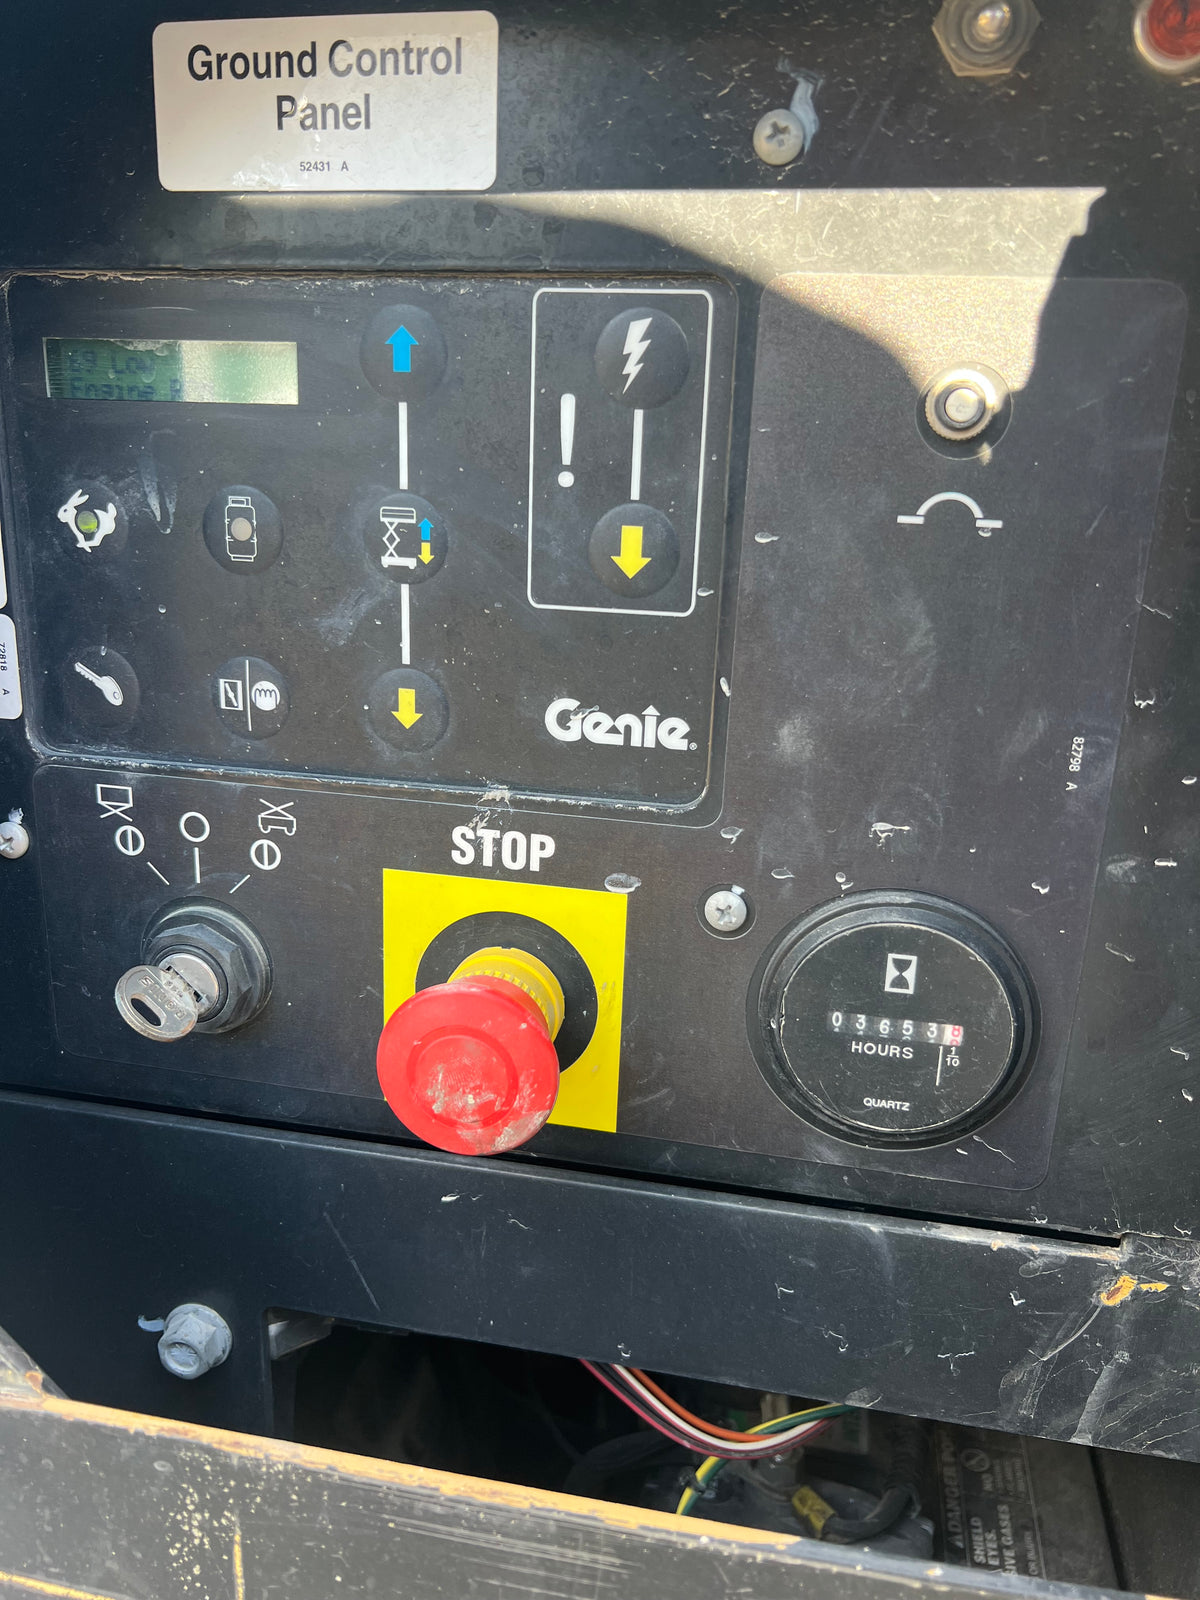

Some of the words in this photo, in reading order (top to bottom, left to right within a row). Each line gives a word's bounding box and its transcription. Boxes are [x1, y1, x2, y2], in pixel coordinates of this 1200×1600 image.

[188, 41, 317, 81] Ground
[328, 36, 462, 78] Control
[276, 93, 371, 131] Panel
[299, 160, 331, 173] 52431
[340, 160, 349, 173] A
[2, 688, 10, 696] A
[1068, 736, 1085, 772] 82798
[1065, 781, 1078, 791] A
[451, 825, 556, 872] STOP
[851, 1040, 914, 1060] HOURS
[863, 1097, 910, 1112] QUARTZ
[971, 1516, 987, 1565] SHIELD
[997, 1504, 1014, 1546] GASES
